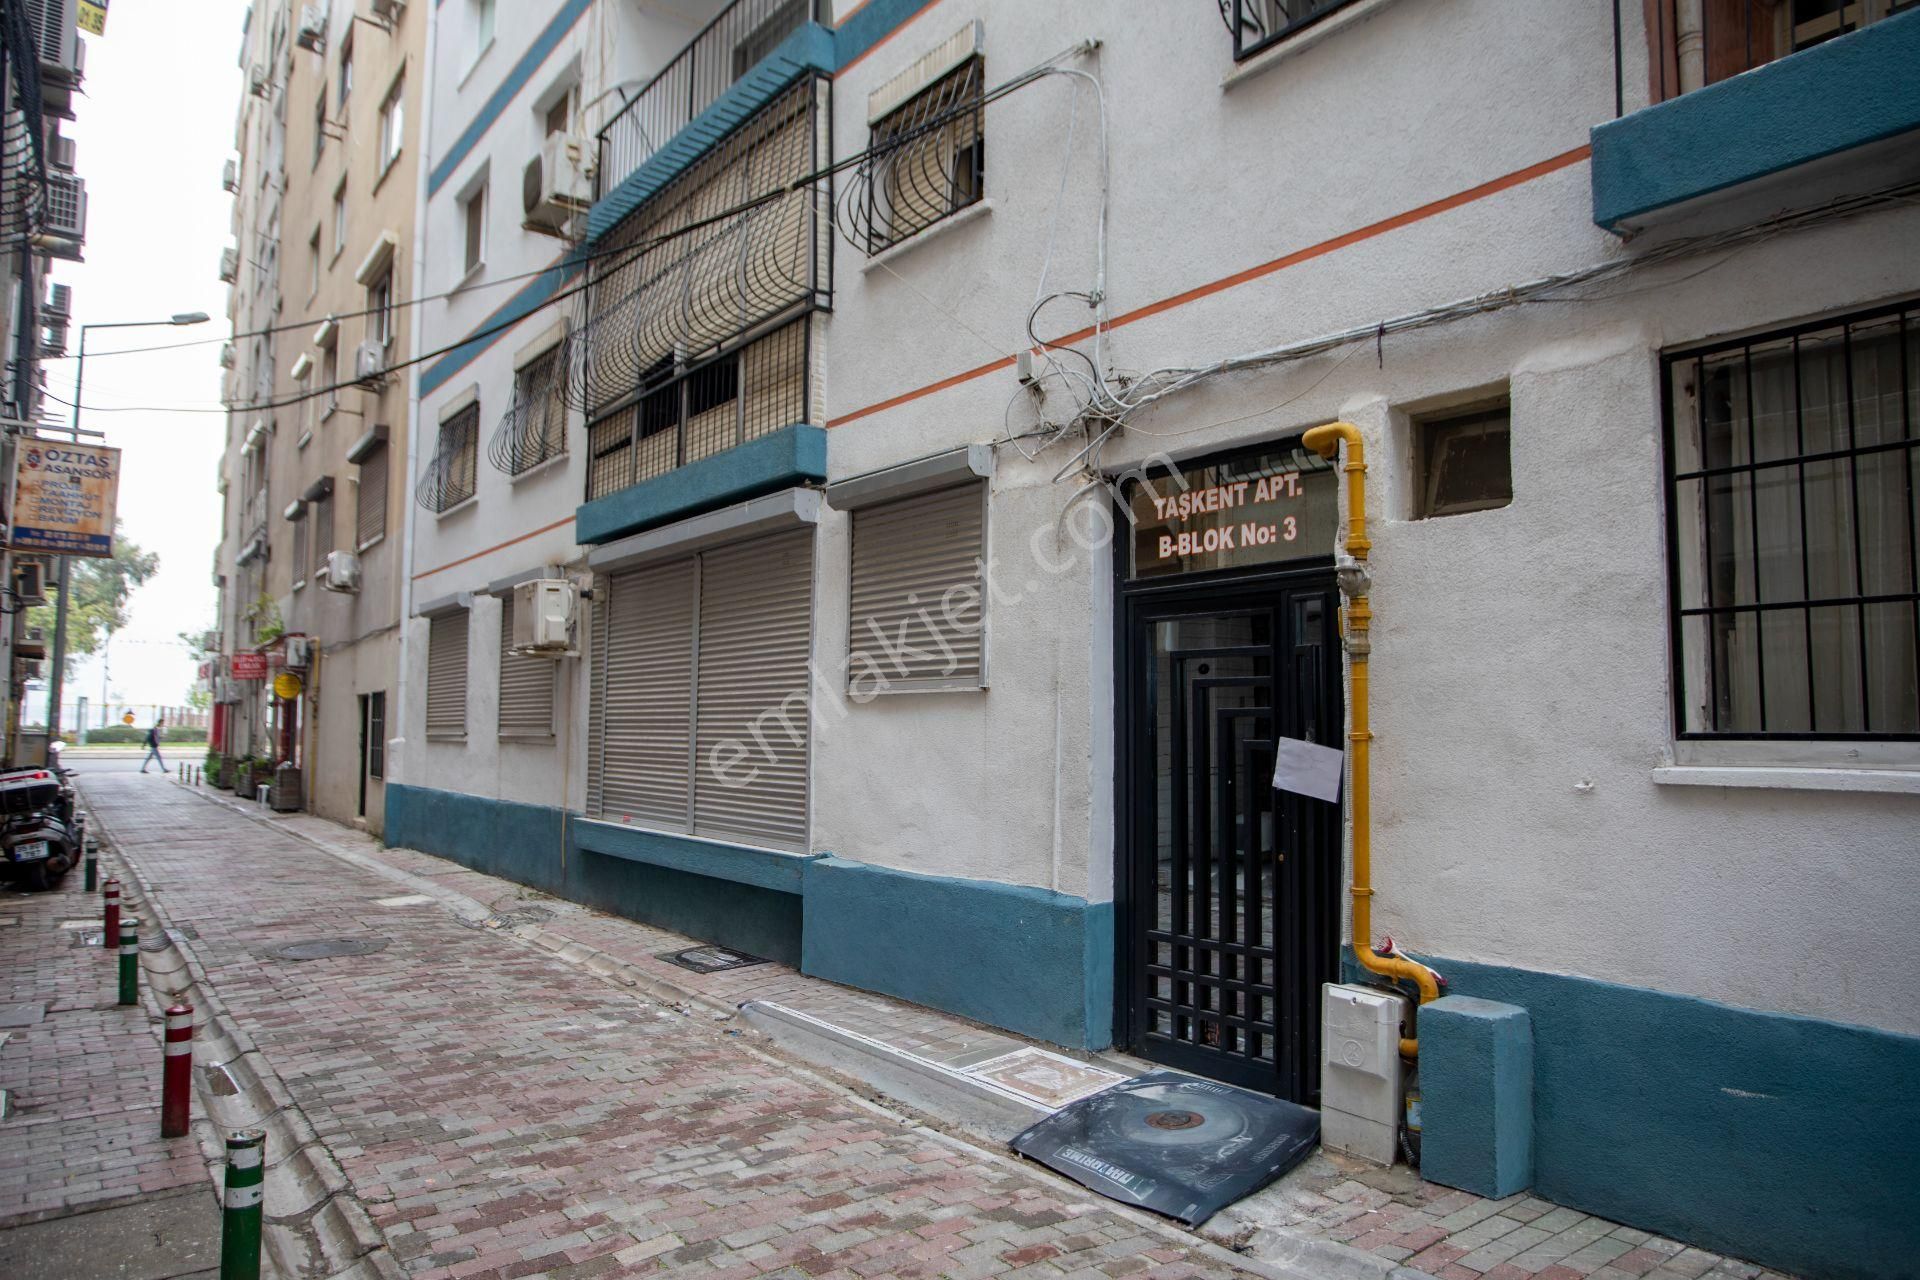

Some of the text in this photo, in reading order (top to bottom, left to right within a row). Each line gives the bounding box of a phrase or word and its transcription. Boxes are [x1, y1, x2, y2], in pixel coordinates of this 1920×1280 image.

[1156, 472, 1304, 522] TAŞKENT APT.
[1159, 516, 1297, 559] B-BLOK No: 3
